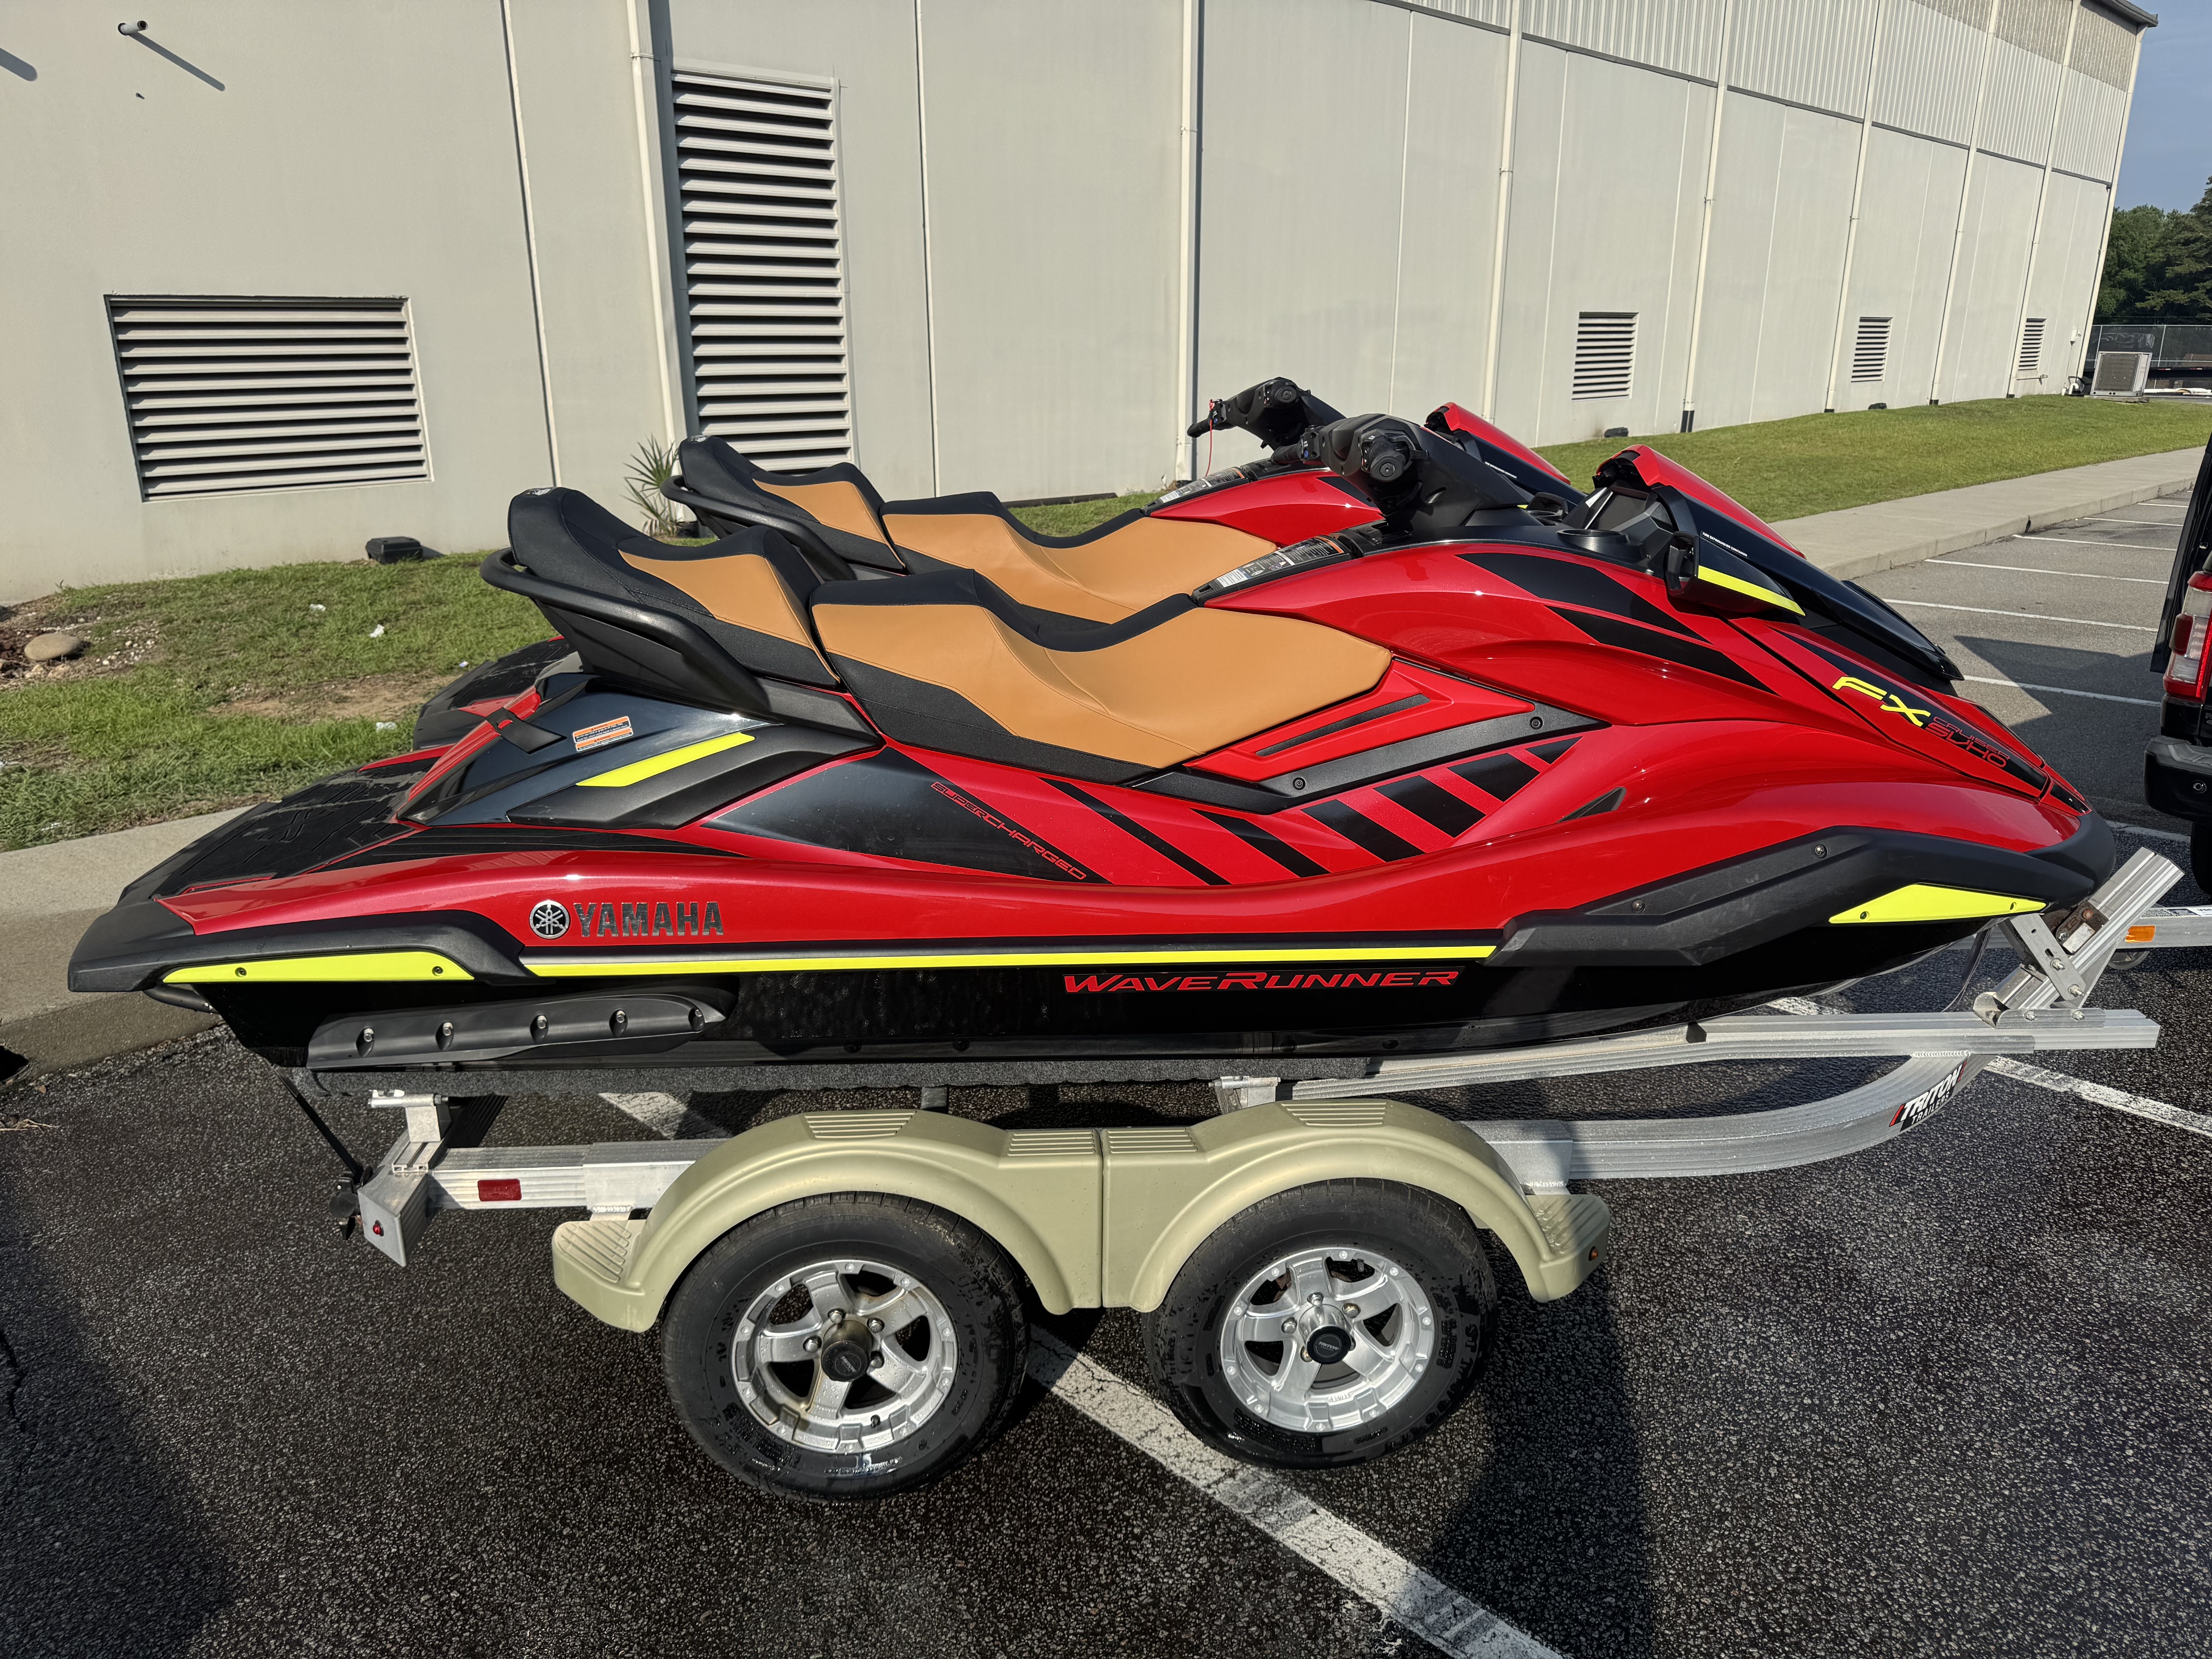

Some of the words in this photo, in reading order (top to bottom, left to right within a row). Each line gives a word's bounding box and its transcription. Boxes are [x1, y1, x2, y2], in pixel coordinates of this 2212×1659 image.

[1832, 676, 1931, 727] FX
[1925, 722, 2007, 768] SVHO
[1933, 716, 2010, 760] CRUISER
[931, 781, 1087, 880] SUPERCHARGED
[573, 901, 724, 937] YAMAHA
[1901, 1064, 1963, 1121] TRITON
[1911, 1091, 1950, 1125] TRAILERS
